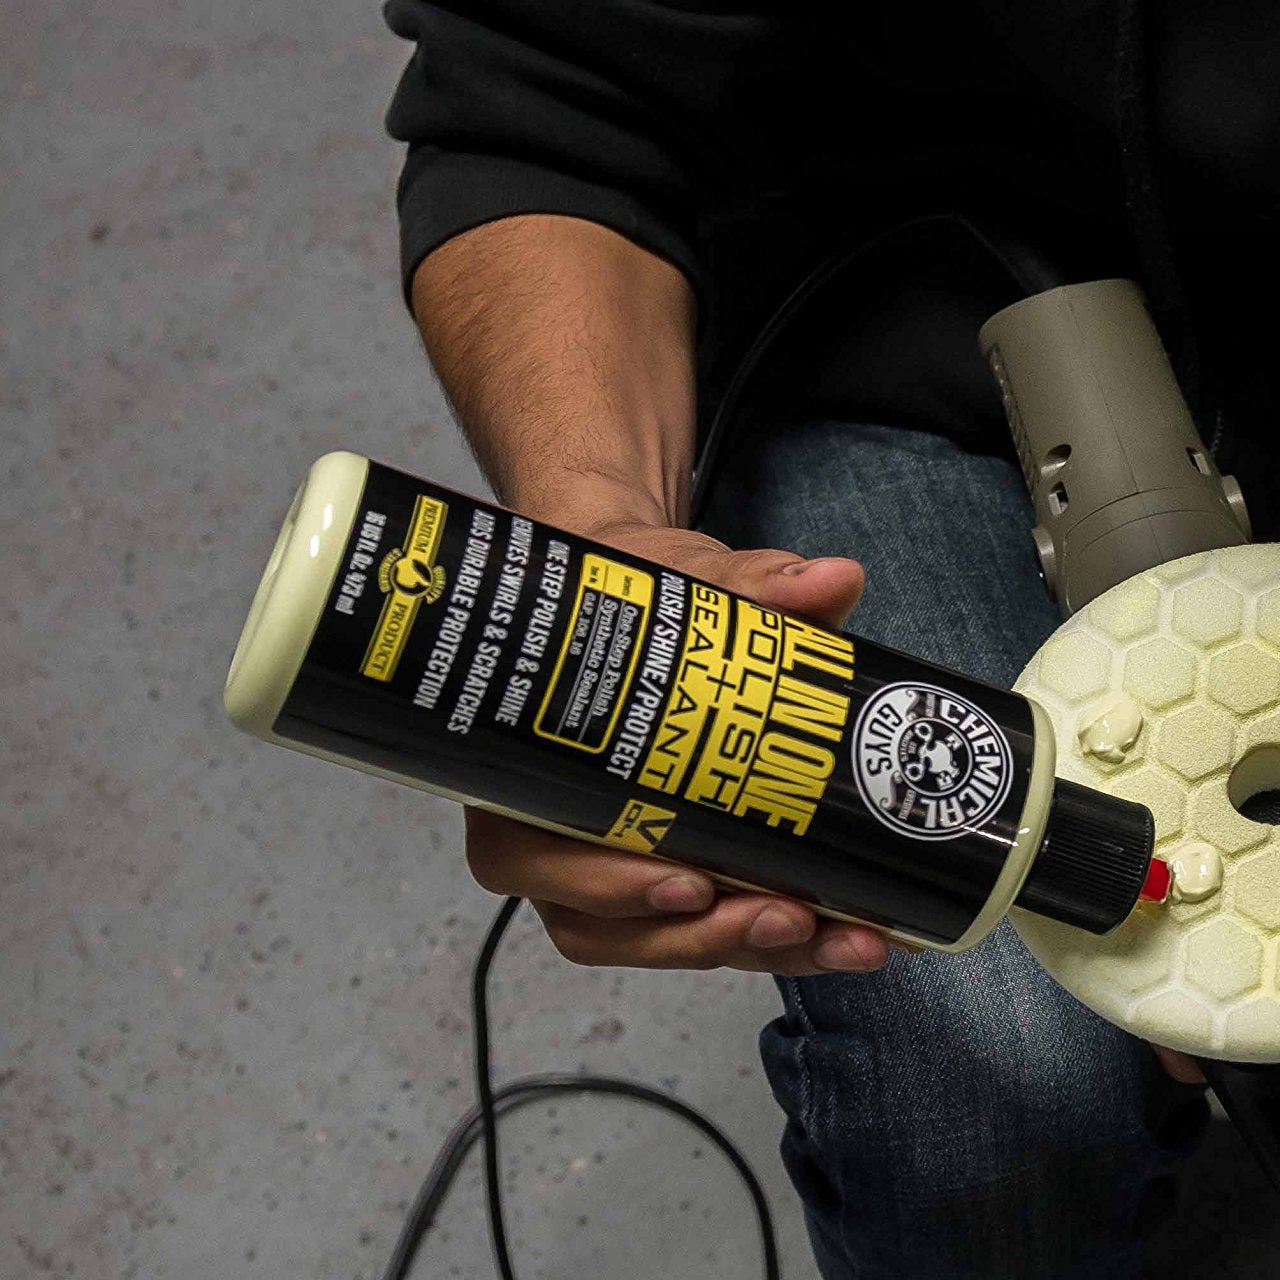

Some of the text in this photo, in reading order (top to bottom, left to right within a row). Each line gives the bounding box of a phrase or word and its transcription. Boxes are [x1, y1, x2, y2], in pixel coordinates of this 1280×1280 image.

[371, 501, 437, 672] PREMIUM PRODUCT
[446, 516, 532, 735] REMOVES SWIRLS & SCRATCHES
[450, 537, 490, 608] DURABLE
[539, 562, 565, 599] STEP
[412, 606, 470, 709] PROTECTION
[514, 656, 539, 672] &
[521, 597, 557, 657] POLISH
[565, 599, 617, 726] Synthetic Sealant
[592, 605, 637, 717] One-Step Polish
[494, 674, 532, 726] SHINE
[646, 586, 718, 789] SEALANT
[698, 606, 780, 808] POLISH
[732, 617, 853, 836] ALL IN ONE
[865, 705, 901, 775] GUYS
[919, 698, 1000, 829] CHEMICAL
[637, 820, 672, 846] V
